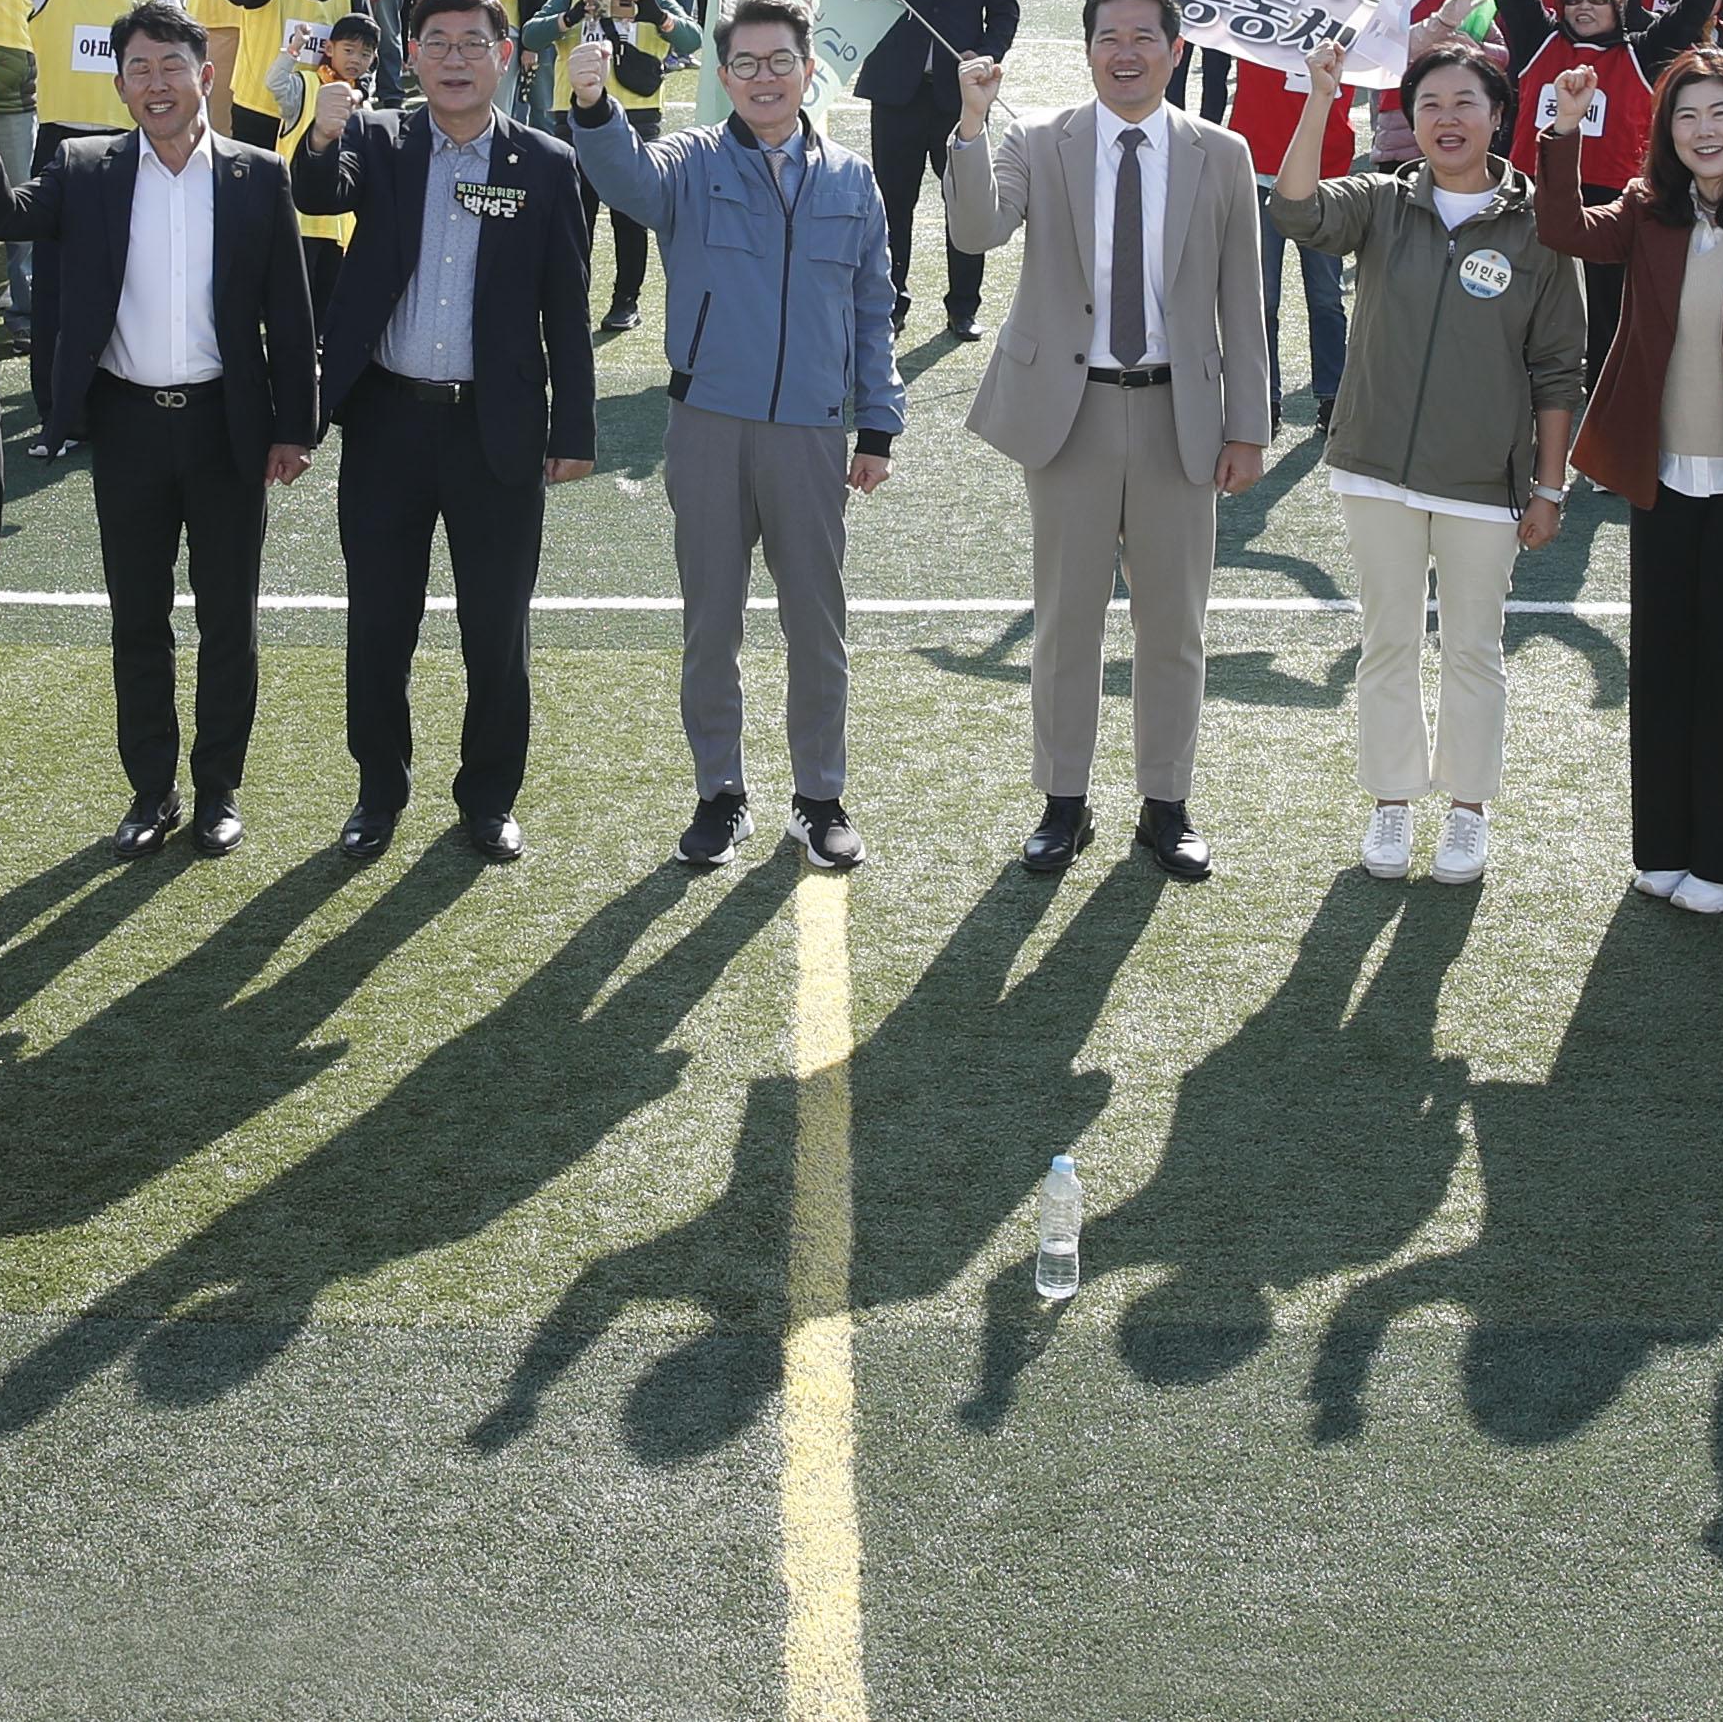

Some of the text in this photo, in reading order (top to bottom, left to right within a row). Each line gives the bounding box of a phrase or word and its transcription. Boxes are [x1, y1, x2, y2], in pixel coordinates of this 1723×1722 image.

[79, 38, 113, 58] 아파
[463, 194, 519, 218] 박성근
[1464, 260, 1508, 287] 이민옥
